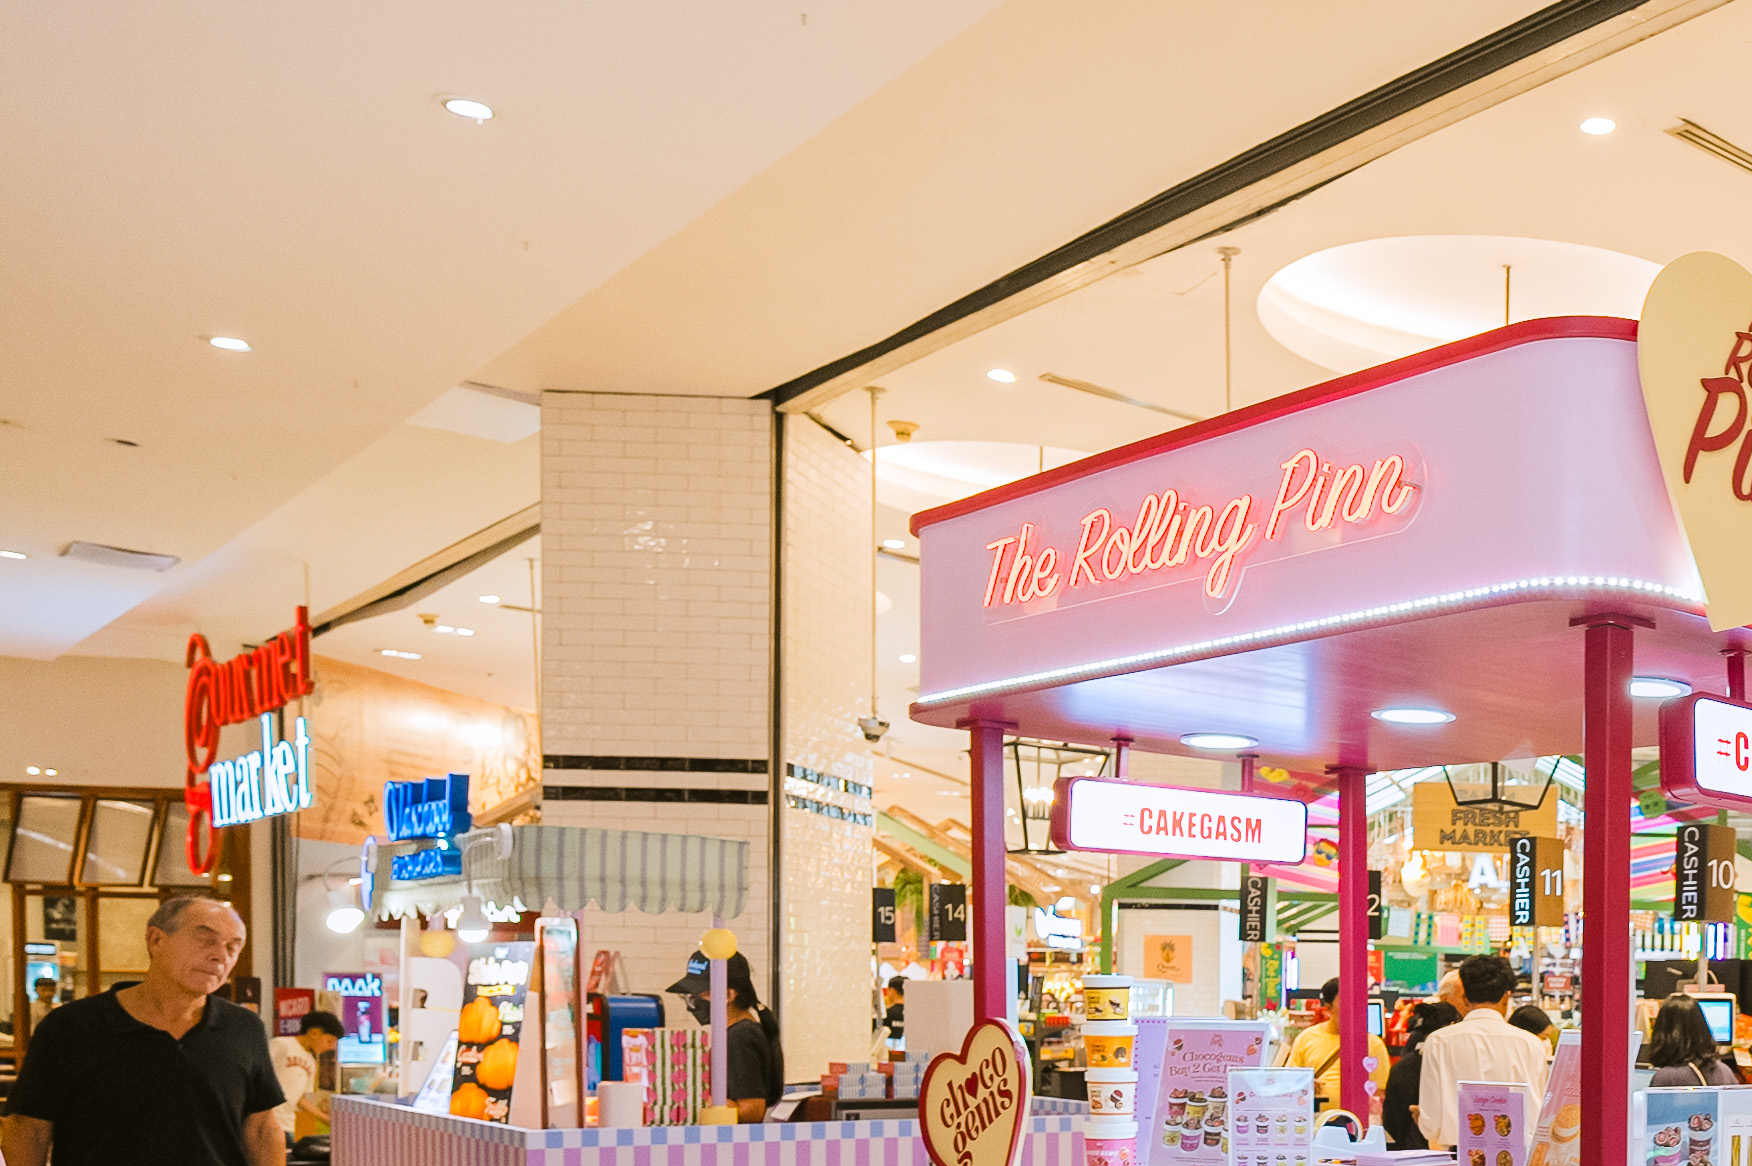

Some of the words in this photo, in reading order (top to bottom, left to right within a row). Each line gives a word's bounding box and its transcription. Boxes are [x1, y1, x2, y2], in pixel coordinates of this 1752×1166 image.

[983, 523, 1062, 607] The
[1070, 489, 1259, 598] Rolling
[1266, 448, 1416, 541] Pinn
[185, 605, 315, 875] Gourmet
[209, 712, 312, 827] market
[1452, 809, 1519, 828] FRESH
[878, 906, 894, 925] 15
[945, 903, 965, 922] 14
[1246, 878, 1262, 941] CASHIER
[1515, 838, 1530, 925] CASHIER
[1540, 869, 1562, 896] 11
[1682, 826, 1699, 920] CASHIER
[1706, 858, 1734, 889] 10
